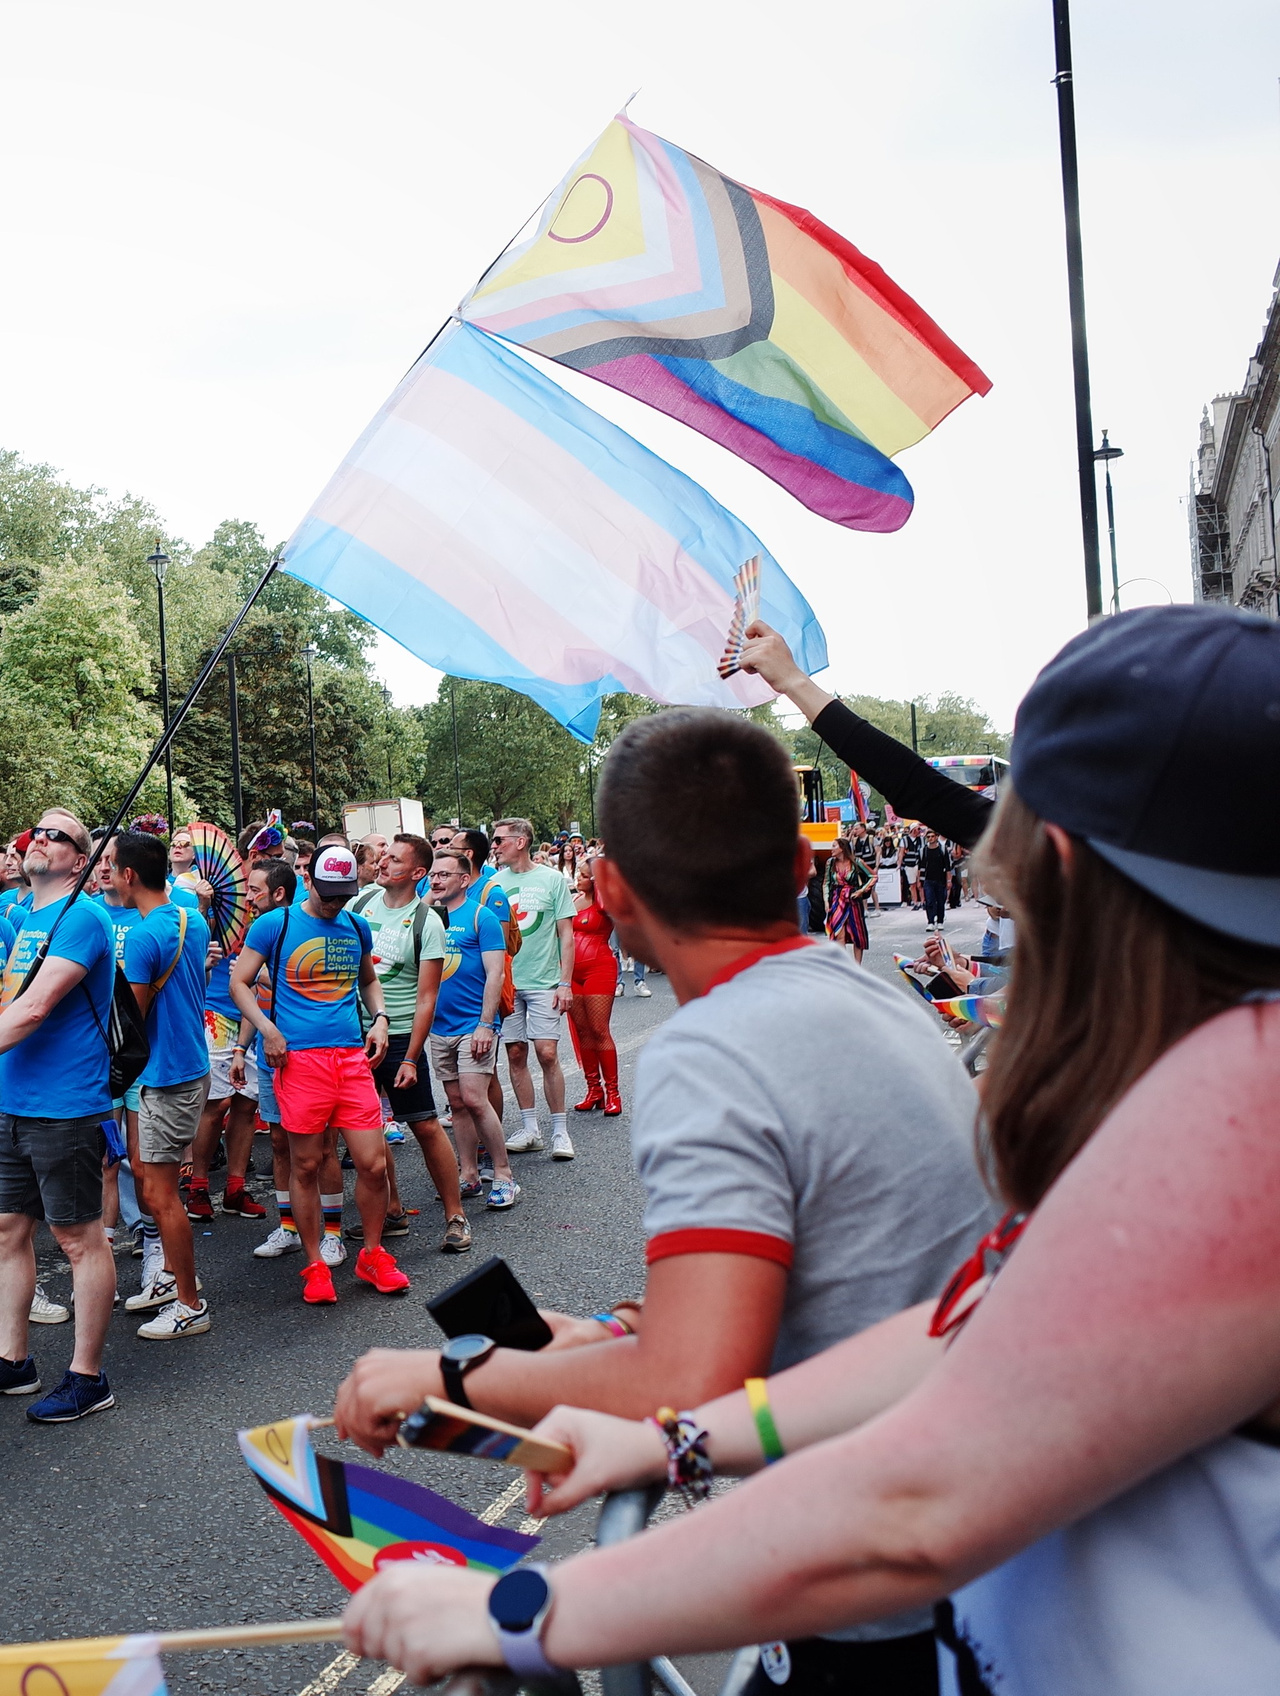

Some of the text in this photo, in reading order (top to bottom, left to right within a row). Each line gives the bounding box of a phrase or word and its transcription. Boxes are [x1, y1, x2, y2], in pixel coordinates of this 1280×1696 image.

[324, 857, 352, 876] Gay
[328, 937, 358, 946] London
[379, 932, 396, 945] Gay
[327, 945, 347, 955] Gay
[376, 940, 400, 953] Men's
[327, 954, 354, 963] Men's
